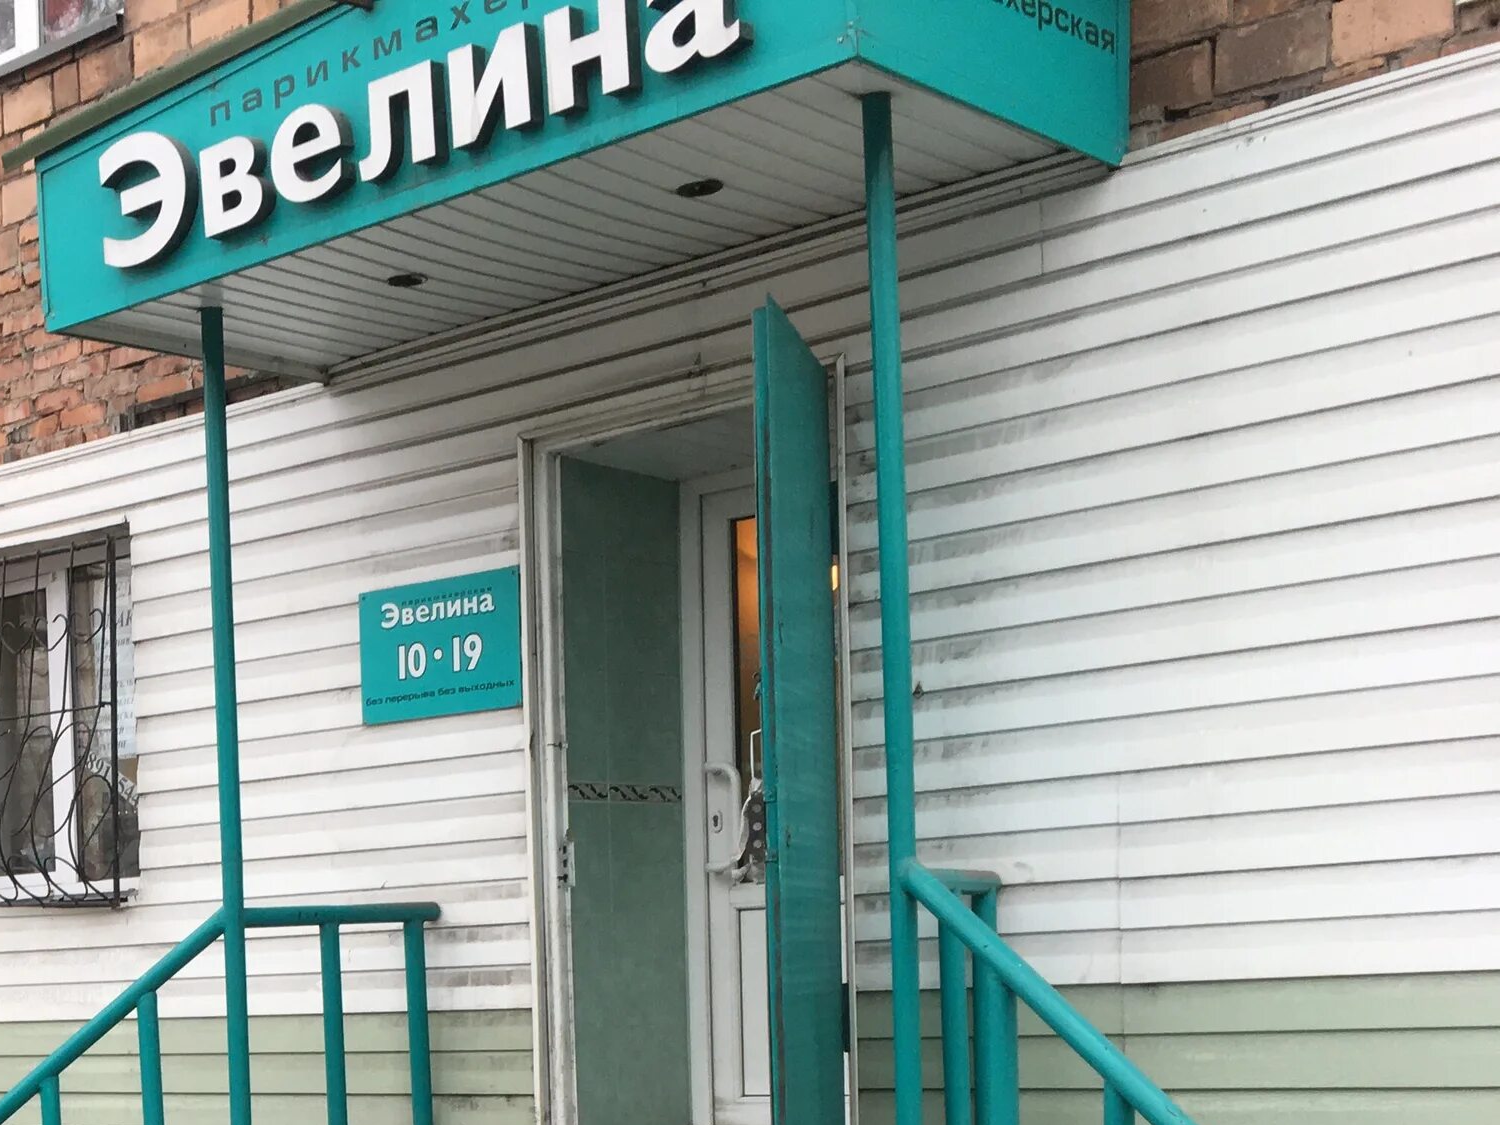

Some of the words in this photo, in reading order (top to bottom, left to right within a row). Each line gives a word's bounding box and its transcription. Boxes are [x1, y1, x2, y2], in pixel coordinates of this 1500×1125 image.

[100, 0, 752, 268] Эвелина
[380, 592, 496, 629] Эвелина
[398, 642, 427, 680] 10
[452, 633, 484, 672] 19
[385, 690, 436, 706] перерыва
[458, 680, 516, 694] выходных
